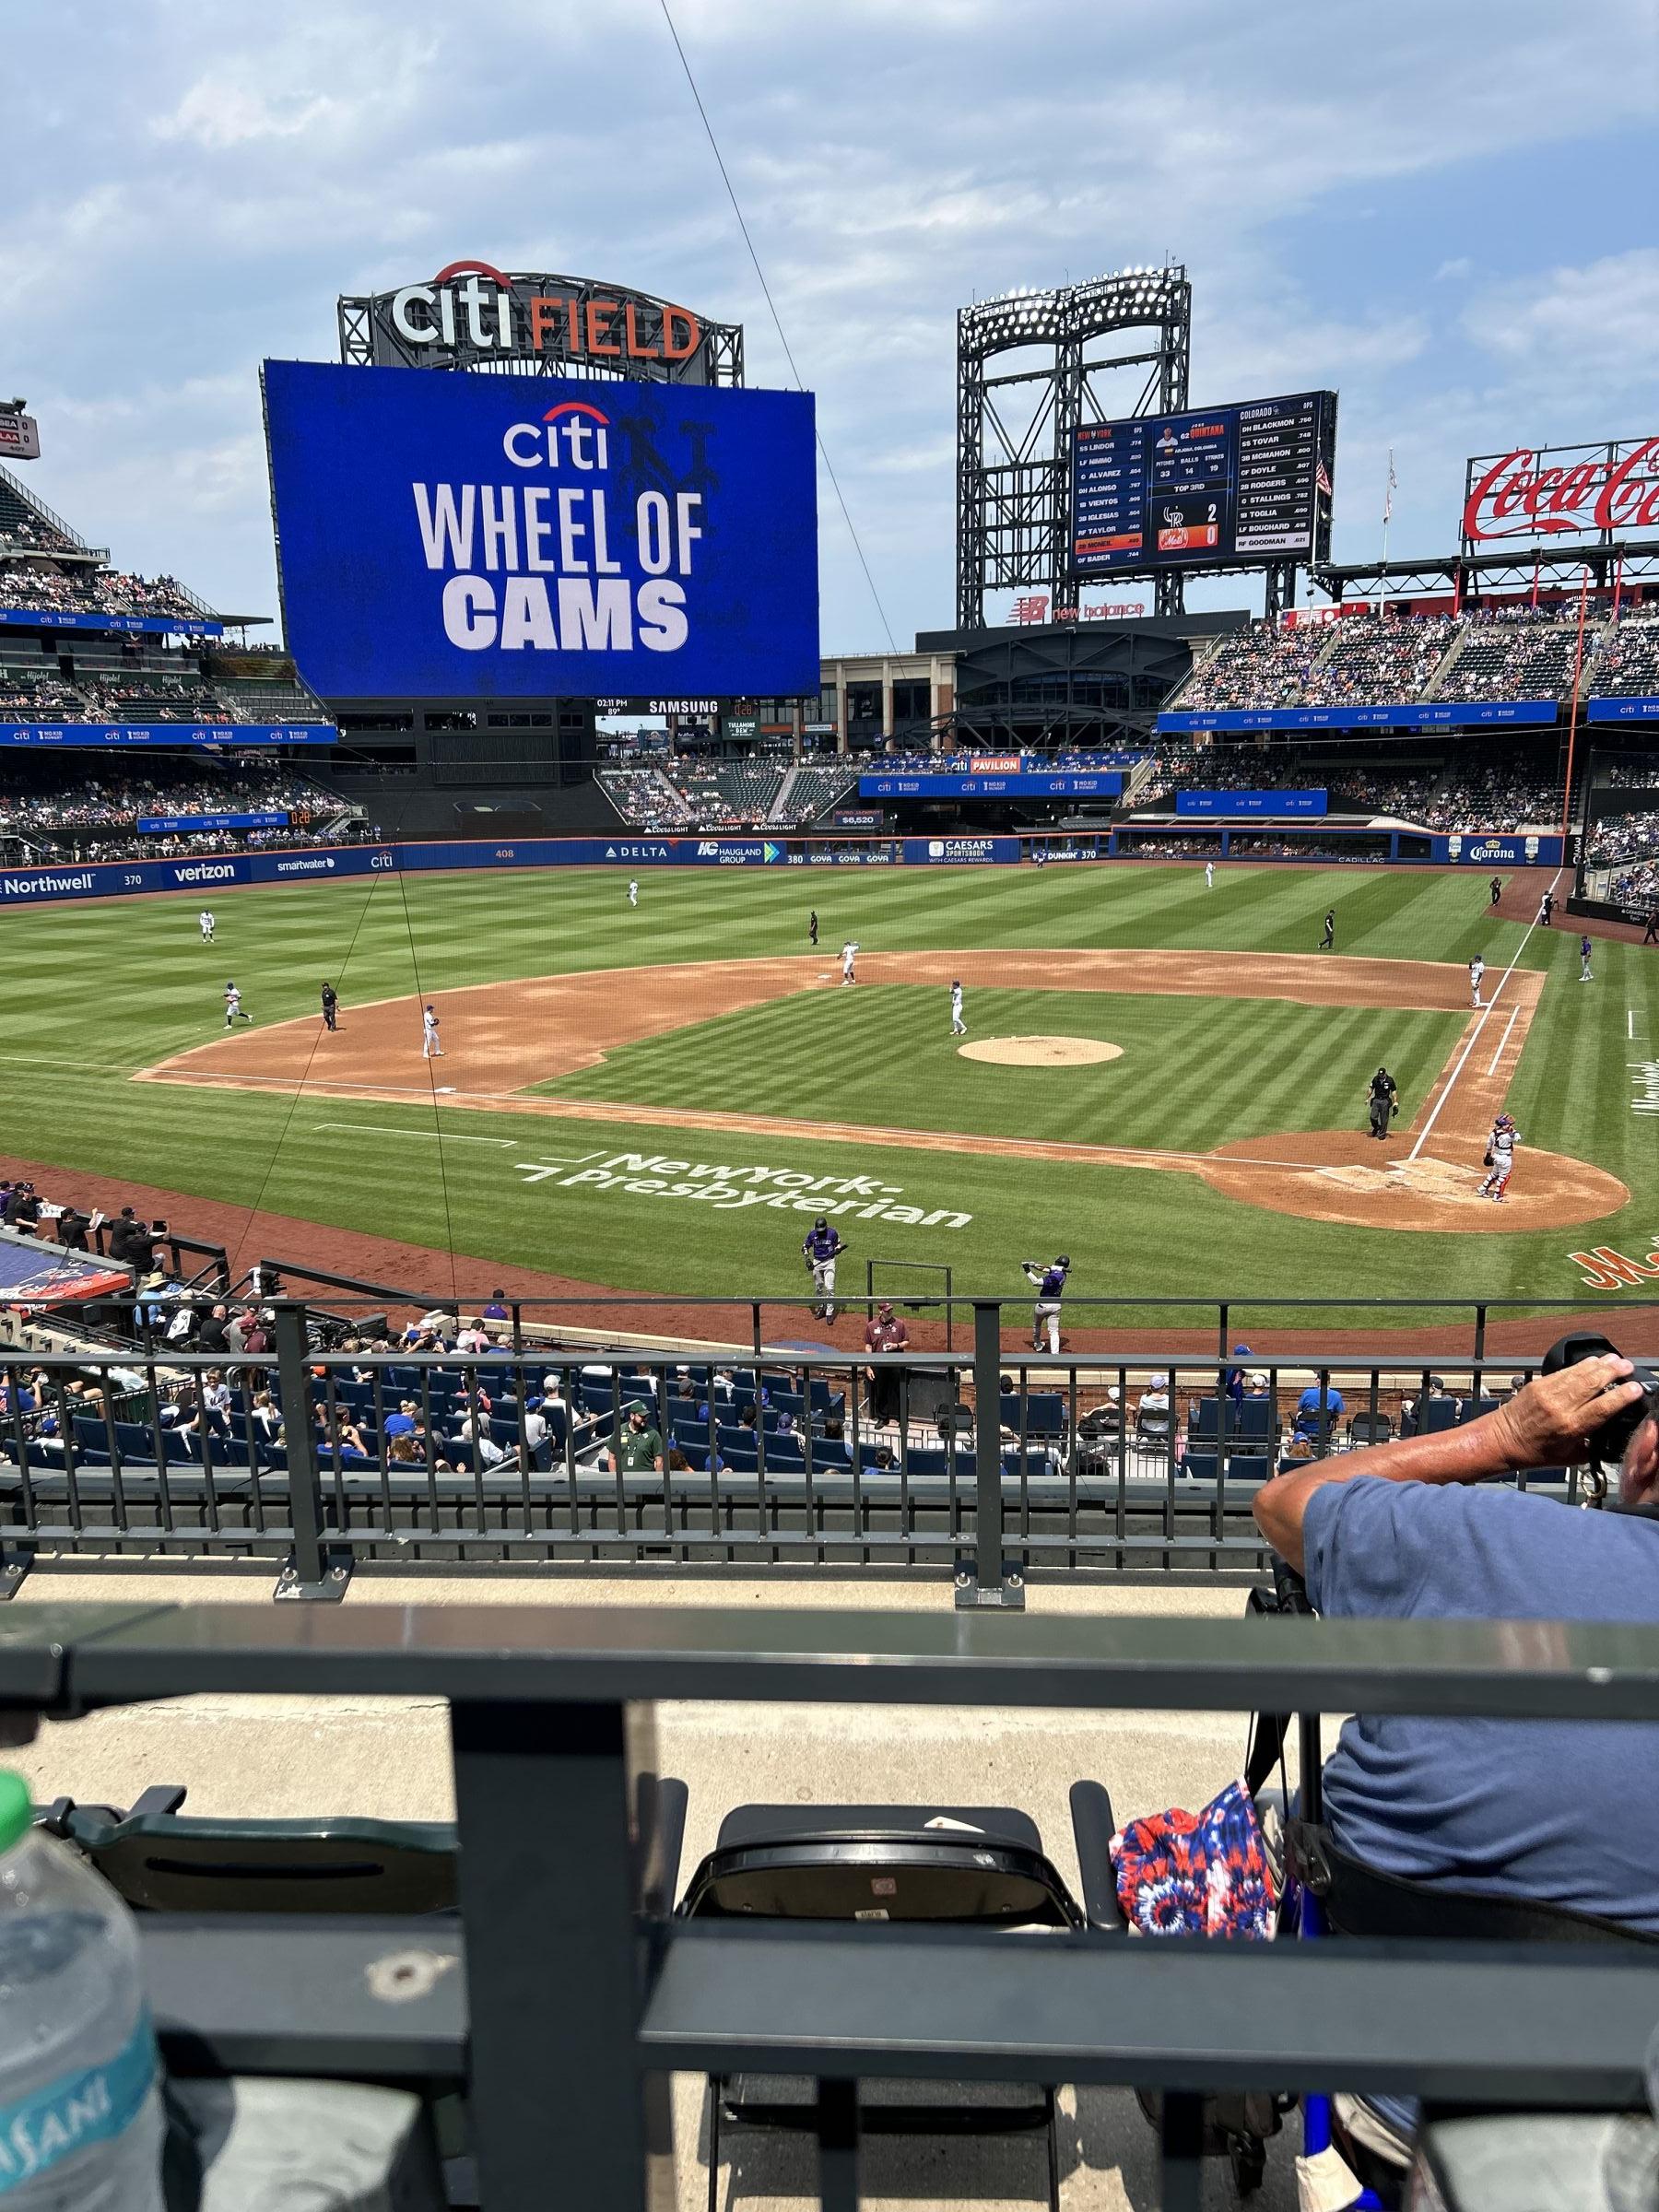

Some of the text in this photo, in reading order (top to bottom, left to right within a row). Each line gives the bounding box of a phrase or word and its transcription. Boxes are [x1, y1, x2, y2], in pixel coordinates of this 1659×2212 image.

[393, 275, 702, 359] citi FIELD
[1240, 407, 1273, 421] COLORADO
[1253, 418, 1295, 431] BLACKMON
[1077, 429, 1112, 441] NEW YORK
[1190, 424, 1224, 440] QUINTANA
[503, 411, 608, 470] citi
[1253, 436, 1279, 446] TOVAR
[1089, 442, 1115, 451] LINDOR
[1180, 456, 1199, 465] BALLS
[1205, 453, 1225, 462] STRIKES
[1252, 449, 1291, 461] MCMAHON
[1209, 464, 1218, 472] 19
[1251, 465, 1277, 476] DOYLE
[1088, 469, 1121, 479] ALVAREZ
[1088, 484, 1117, 493] ALONSO
[1174, 483, 1206, 493] TOP 3RD
[1251, 478, 1287, 489] RODGERS
[1088, 498, 1118, 507] VIENTOS
[1250, 493, 1291, 503] STALLINGS
[1088, 512, 1119, 521] IGLESIAS
[1207, 503, 1217, 523] 2
[1250, 509, 1277, 518] TOGLIA
[412, 483, 702, 576] WHEEL OF
[1088, 526, 1116, 535] TAYLOR
[1249, 523, 1290, 533] BOUCHARD
[1206, 525, 1216, 545] 0
[1249, 537, 1287, 547] GOODMAN
[1088, 554, 1111, 563] BADER
[441, 574, 689, 652] CAMS
[1052, 602, 1145, 620] new balance
[596, 699, 628, 707] 02:11 PM
[649, 700, 718, 713] SAMSUNG
[1620, 705, 1634, 713] citi
[14, 731, 29, 740] citi
[104, 731, 120, 740] citi
[192, 732, 206, 740] citi
[951, 759, 1018, 771] citi PAVILION
[877, 782, 891, 792] citi
[961, 782, 976, 792] citi
[1050, 781, 1065, 791] citi
[291, 811, 311, 825] 0:28
[842, 817, 875, 825] $6,520
[705, 823, 725, 831] Coors
[759, 822, 780, 830] Coors
[946, 841, 994, 850] CAESARS
[495, 849, 515, 859] 408
[621, 845, 667, 858] DELTA
[719, 848, 762, 856] HAUGLAND
[1048, 852, 1078, 860] DUNKIN'
[1081, 850, 1097, 859] 370
[1470, 845, 1515, 862] Corona
[371, 853, 393, 868] citi
[720, 856, 747, 865] GROUP
[787, 855, 804, 864] 380
[866, 854, 889, 863] GOYA
[277, 858, 327, 872] smartwater
[174, 863, 235, 882] verizon
[5, 873, 92, 895] Northwell
[124, 875, 142, 886] 370
[556, 1169, 974, 1229] Presbyterian
